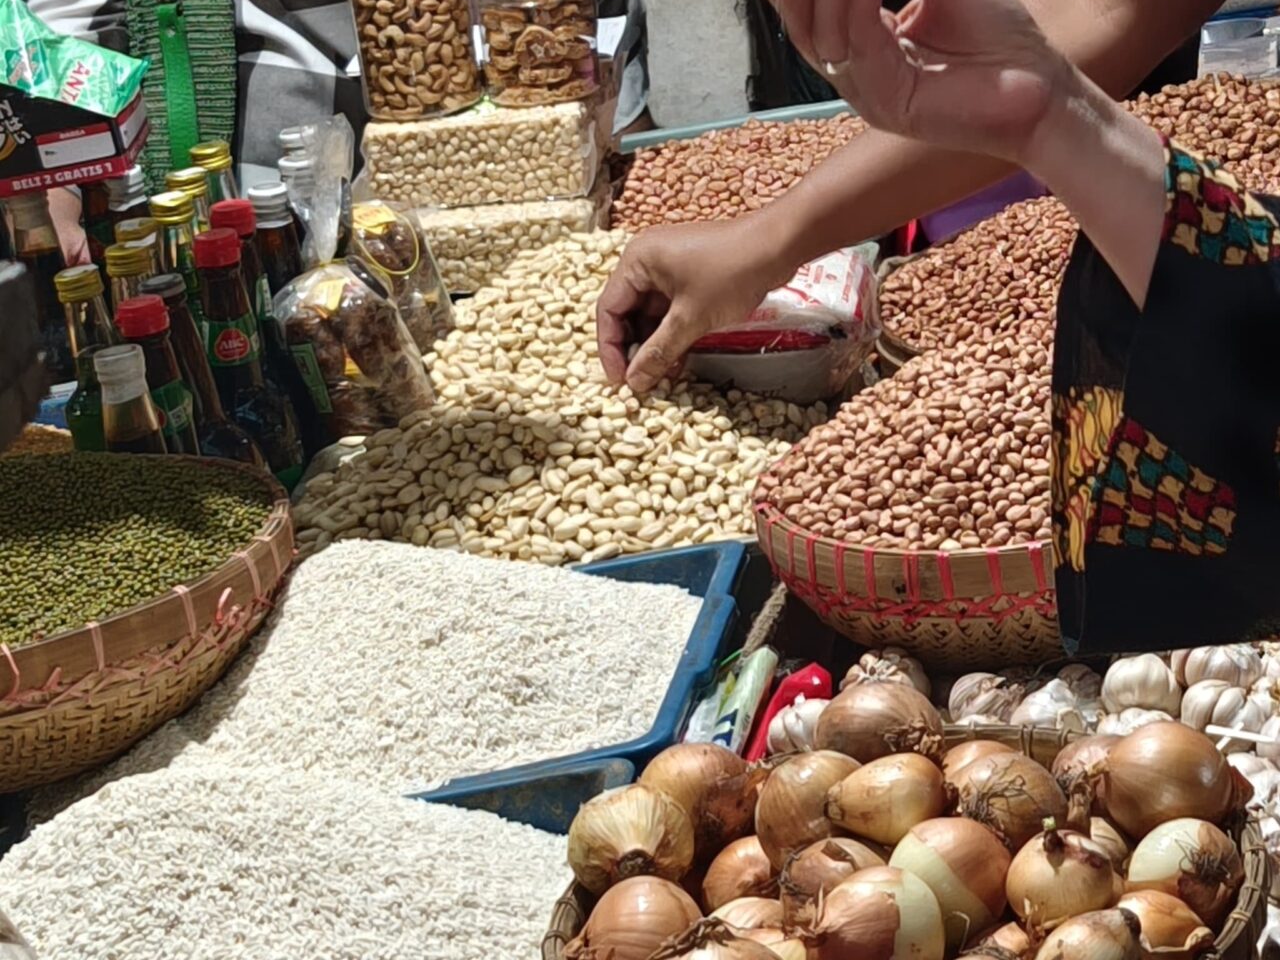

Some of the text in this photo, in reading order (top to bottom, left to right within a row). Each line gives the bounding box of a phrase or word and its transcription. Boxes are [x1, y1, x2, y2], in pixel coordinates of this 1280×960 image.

[12, 162, 113, 191] BELI 2 GRATIS 1
